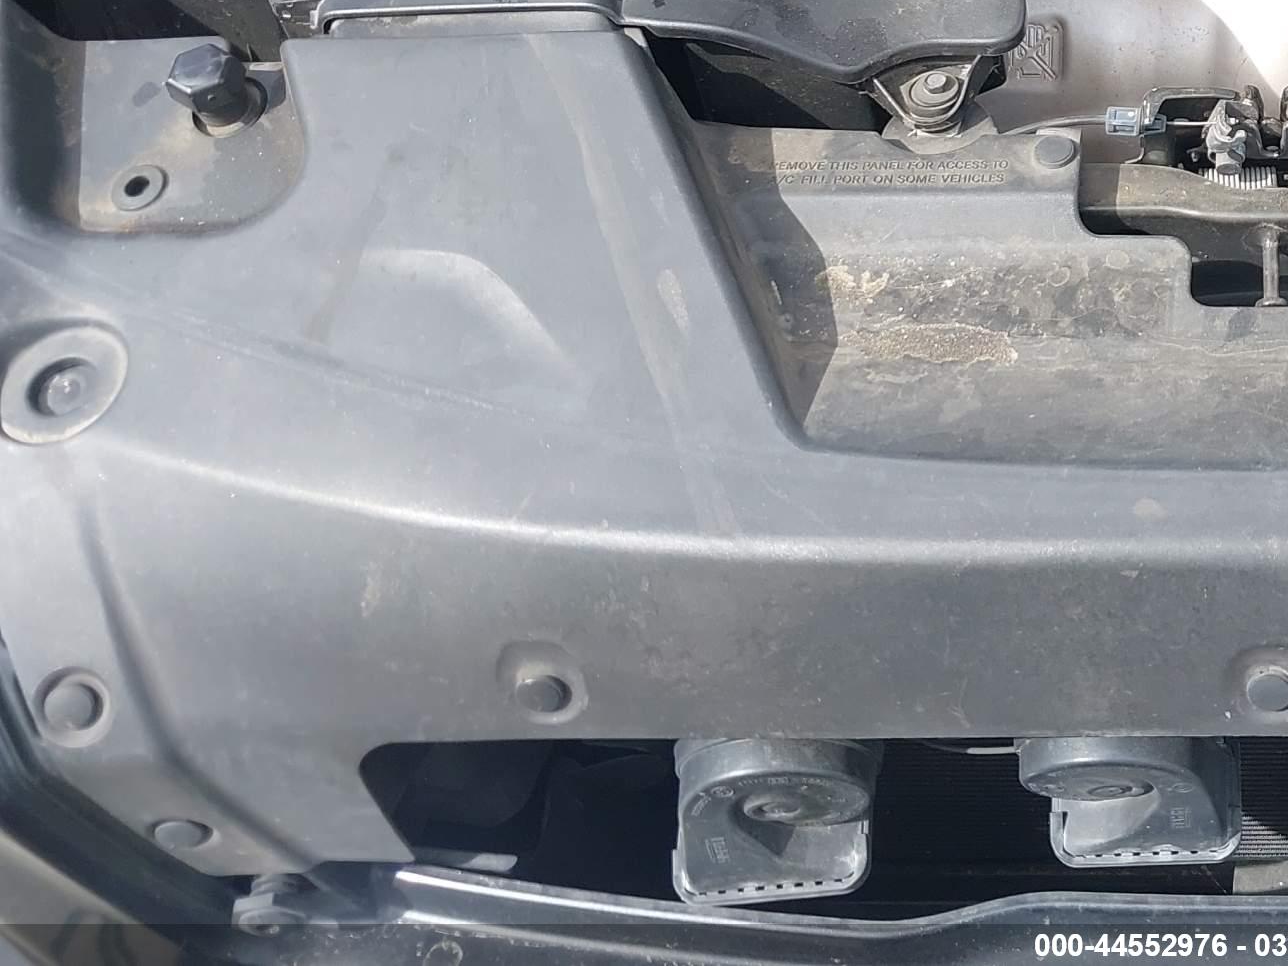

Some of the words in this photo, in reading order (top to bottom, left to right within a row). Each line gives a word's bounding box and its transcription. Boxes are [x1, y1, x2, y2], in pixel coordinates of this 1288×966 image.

[829, 161, 858, 171] THIS
[862, 161, 905, 171] PANEL
[907, 160, 934, 170] FOR
[937, 160, 988, 170] ACCESS
[992, 159, 1009, 170] TO
[800, 174, 829, 185] FILL
[833, 174, 869, 185] PORT
[873, 174, 894, 184] ON
[897, 174, 937, 184] SOME
[941, 173, 1004, 184] VEHICLES
